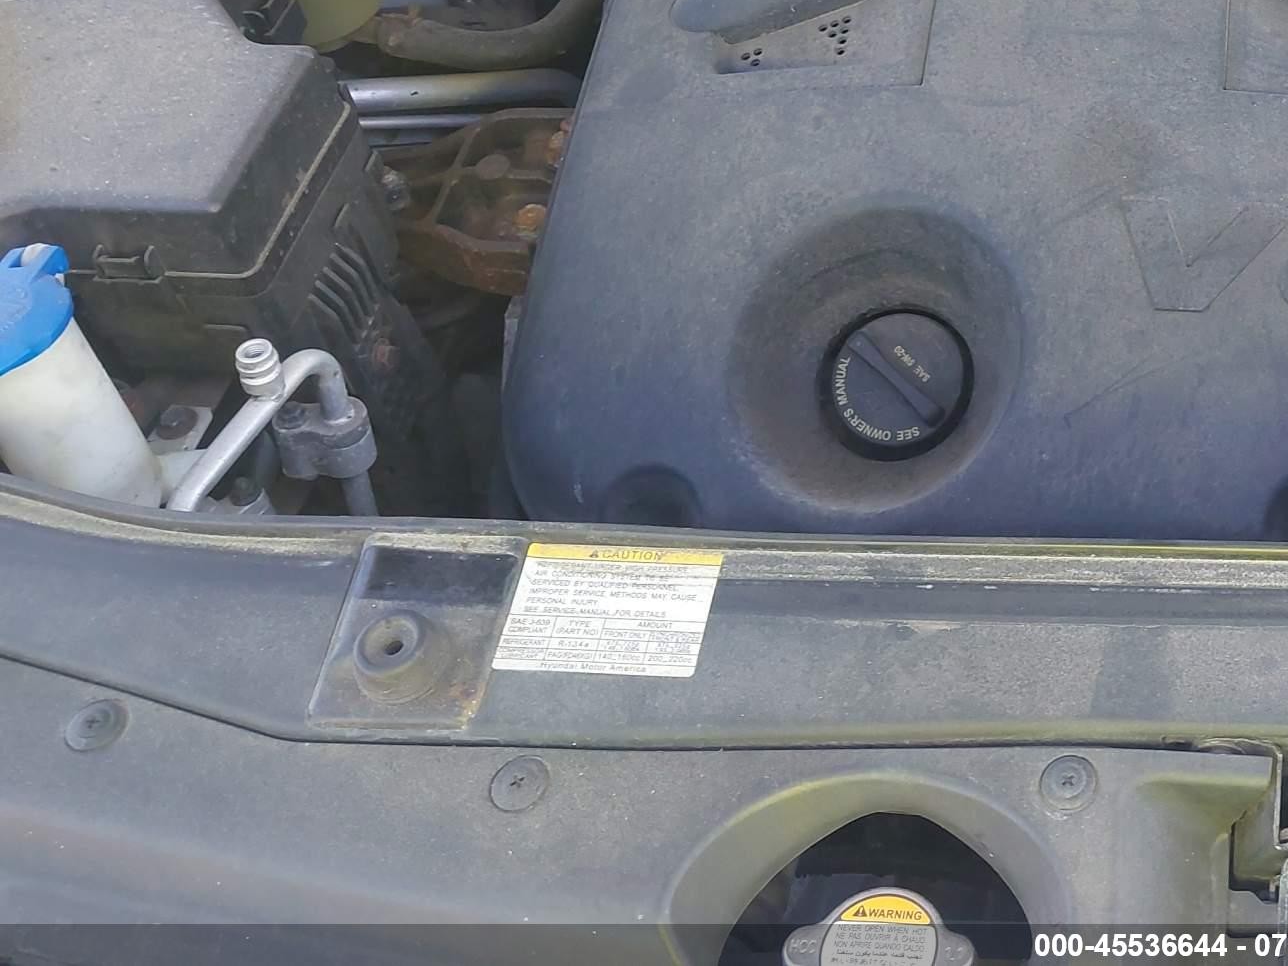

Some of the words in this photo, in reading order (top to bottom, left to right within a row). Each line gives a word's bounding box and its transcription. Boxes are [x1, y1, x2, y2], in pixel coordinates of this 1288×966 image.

[914, 365, 931, 382] SAE
[835, 355, 852, 406] MANUAL
[843, 408, 891, 441] OWNER'S
[896, 426, 920, 441] SEE
[602, 549, 664, 561] CAUTION
[526, 597, 566, 605] PERSONAL
[529, 588, 569, 596] IMPROPER
[573, 589, 606, 598] SERVICE
[610, 591, 648, 599] METHODS
[651, 593, 668, 601] MAY
[671, 594, 698, 602] CAUSE
[508, 626, 548, 634] COMPLIANT
[540, 662, 577, 671] Hyundai
[581, 663, 606, 672] Motor
[609, 664, 647, 673] America
[868, 908, 922, 921] WARNING
[837, 924, 862, 932] NEVER
[865, 925, 885, 933] OPEN
[887, 926, 909, 934] WHEN
[911, 928, 928, 936] HOT
